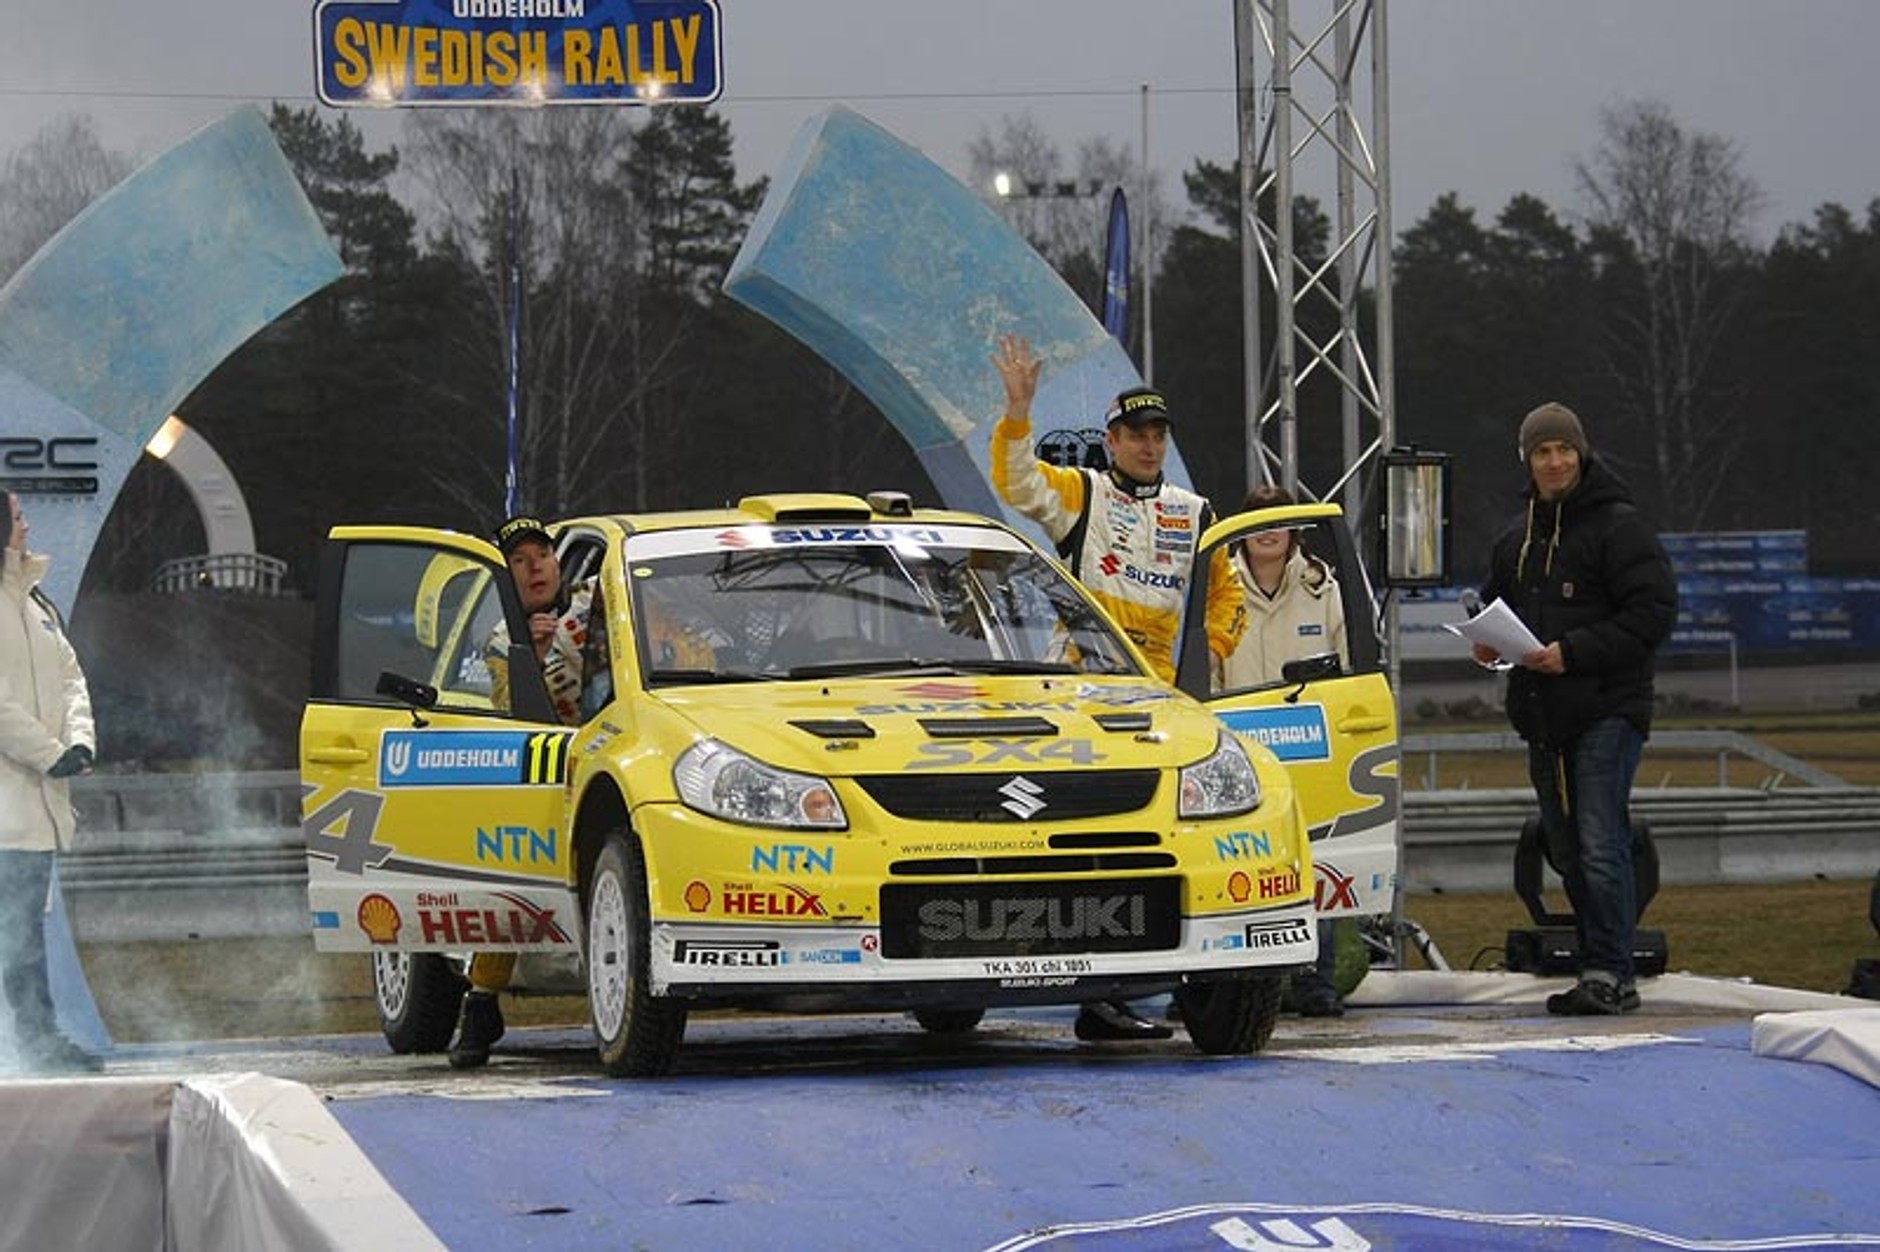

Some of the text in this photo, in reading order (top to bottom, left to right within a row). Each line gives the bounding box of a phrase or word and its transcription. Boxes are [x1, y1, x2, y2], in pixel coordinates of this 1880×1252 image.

[453, 0, 584, 18] UDDEHOLM
[334, 14, 702, 88] SWEDISH RALLY
[857, 703, 1077, 715] SUZUKI
[417, 749, 518, 769] UDDEHOLM
[529, 732, 564, 784] 11
[903, 739, 1108, 770] SX4
[476, 826, 557, 864] NTN
[752, 845, 834, 874] NTN
[901, 839, 1046, 854] WWW.GLOBALSUZUKI.COM
[1214, 831, 1272, 862] NTN
[417, 893, 459, 907] Shell
[723, 885, 829, 917] HELIX
[417, 892, 574, 944] HELIX
[918, 895, 1147, 942] SUZUKI
[1246, 919, 1312, 948] PIRELLI
[673, 939, 780, 966] PIRELLI
[983, 962, 1013, 975] TKA
